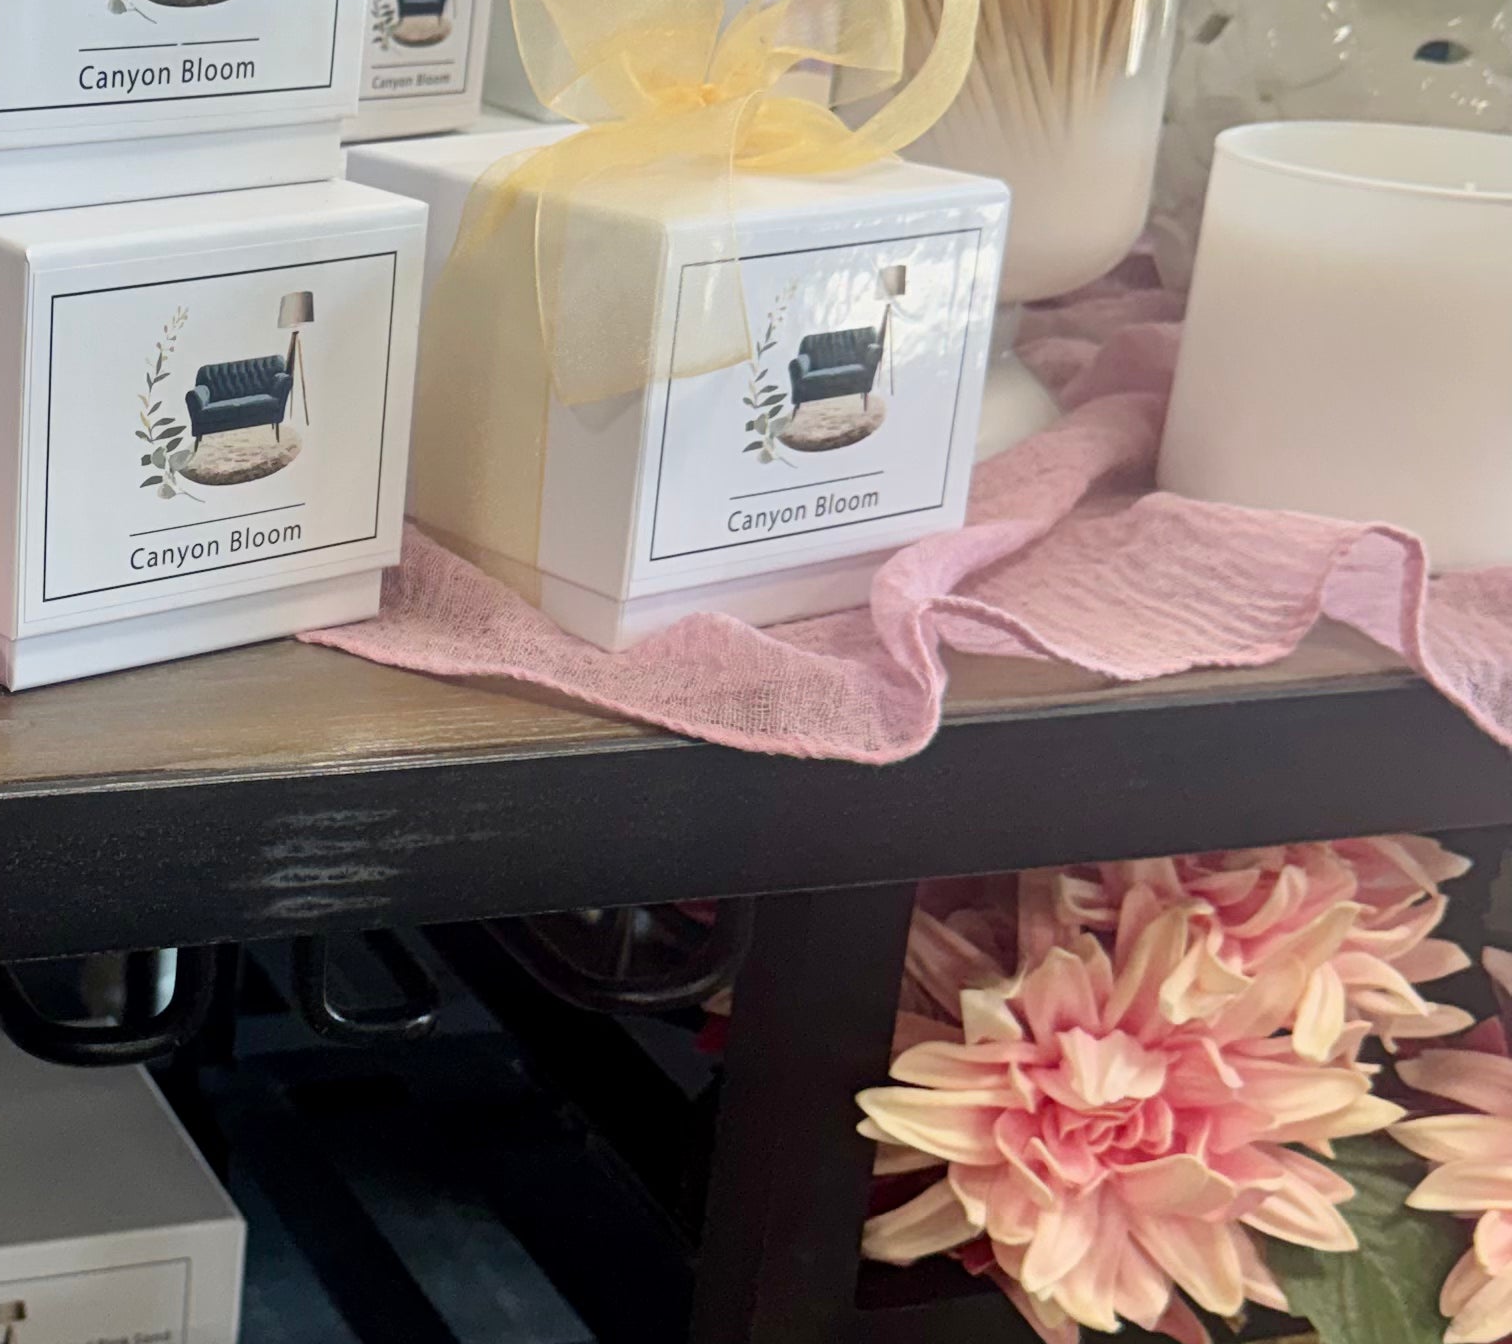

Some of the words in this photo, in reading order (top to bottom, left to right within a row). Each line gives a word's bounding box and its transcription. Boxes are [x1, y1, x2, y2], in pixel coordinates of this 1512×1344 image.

[79, 65, 171, 94] Canyon
[181, 57, 255, 83] Bloom
[727, 504, 807, 532] Canyon
[814, 491, 880, 517] Bloom
[130, 539, 220, 570] Canyon
[230, 523, 303, 553] Bloom
